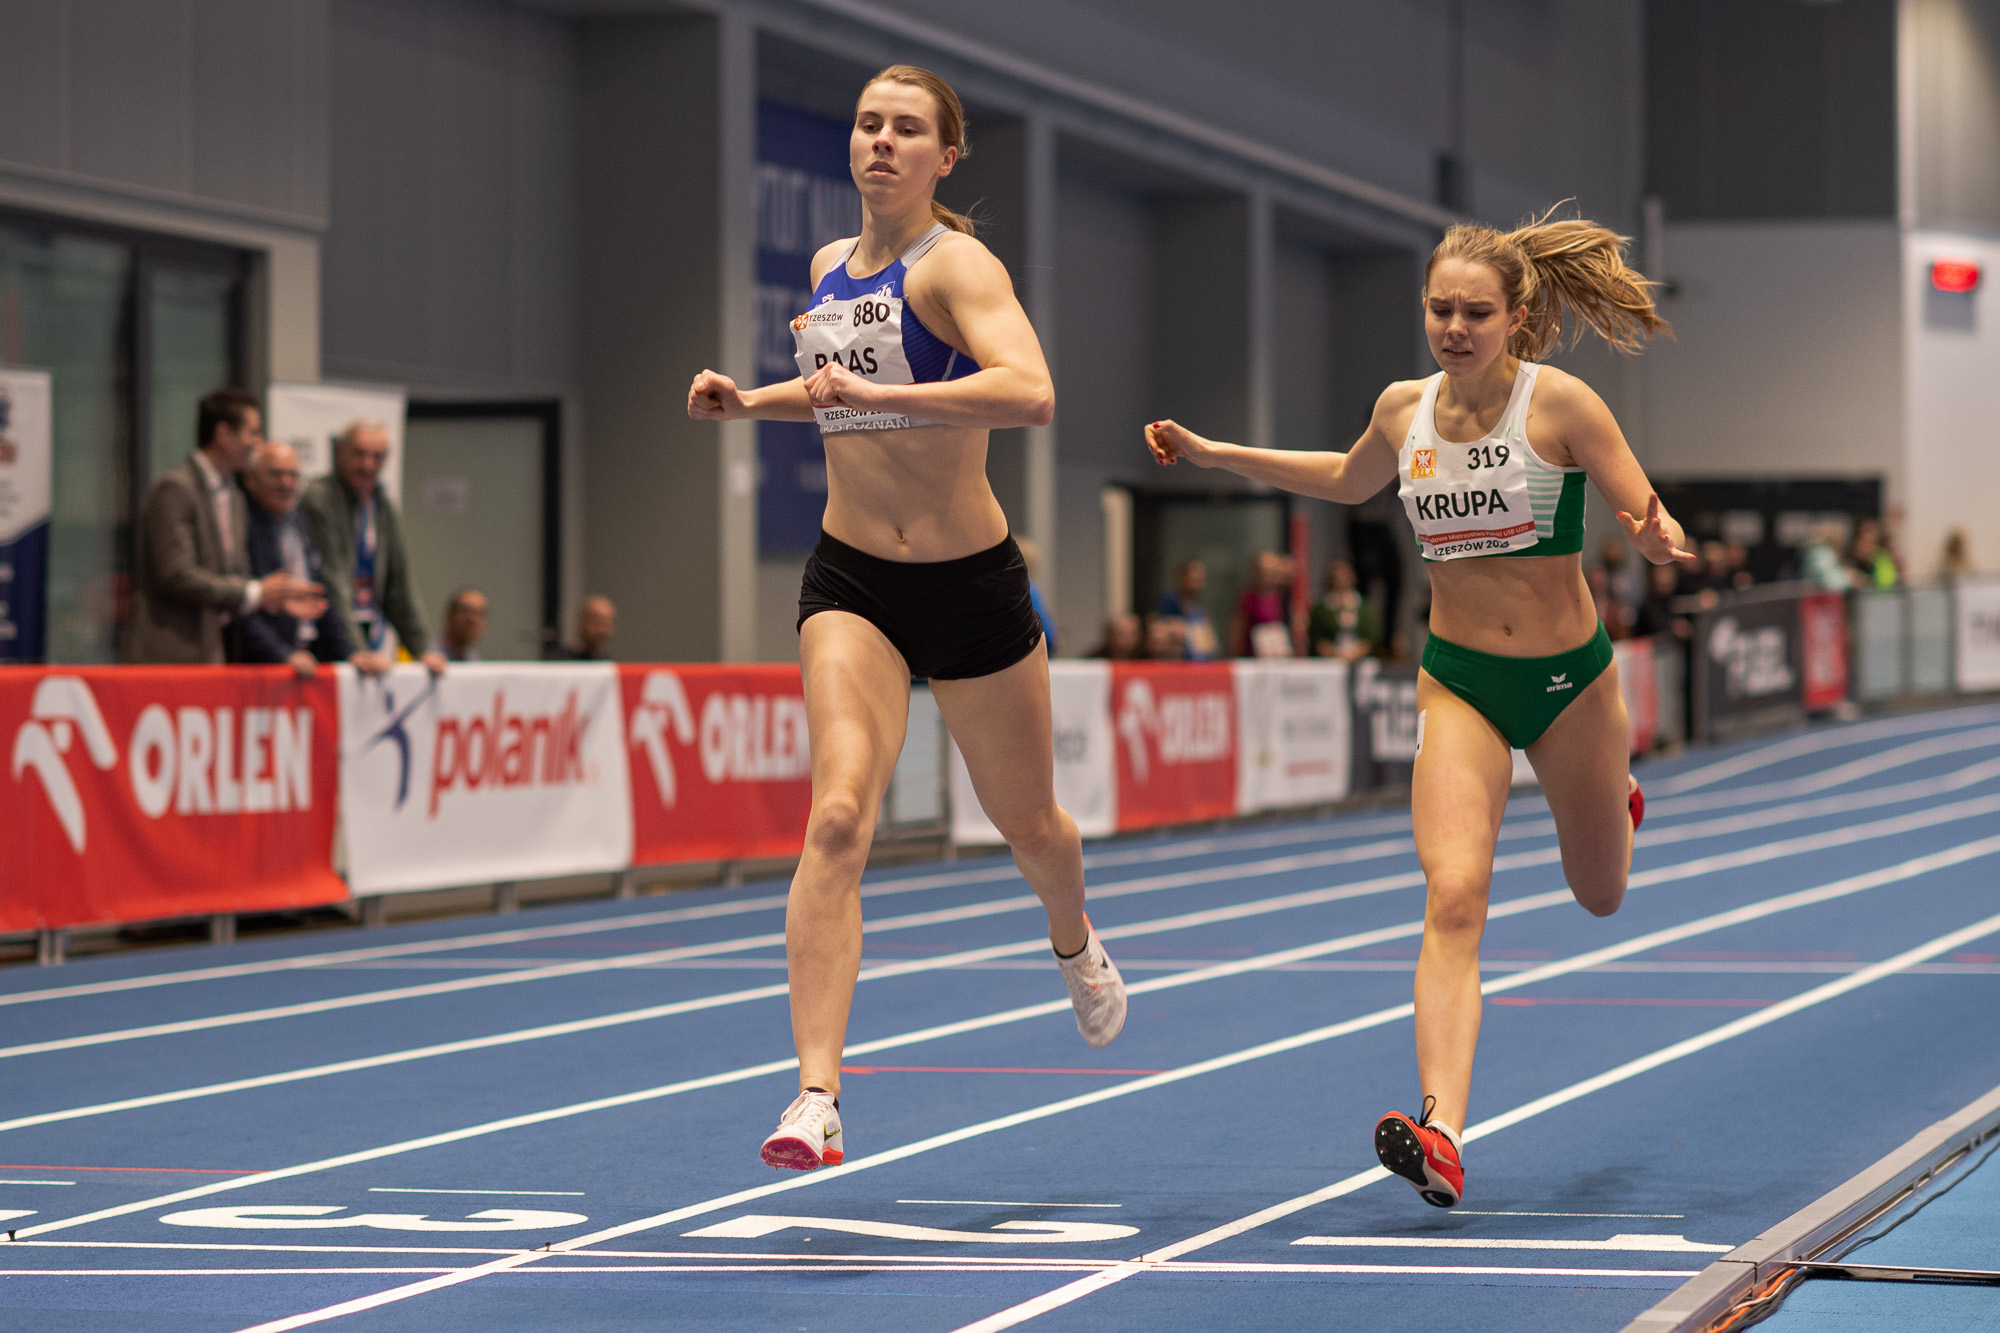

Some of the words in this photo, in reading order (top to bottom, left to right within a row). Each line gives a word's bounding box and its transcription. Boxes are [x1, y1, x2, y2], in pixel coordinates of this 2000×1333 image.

[809, 312, 844, 322] rzeszów
[853, 301, 890, 327] 880
[1467, 445, 1510, 470] 319
[1415, 488, 1509, 520] KRUPA
[1503, 528, 1515, 536] U18
[1515, 524, 1529, 533] U20
[1546, 682, 1573, 693] erima
[129, 703, 314, 818] ORLEN
[429, 690, 588, 819] polanik
[679, 1214, 1141, 1244] 2
